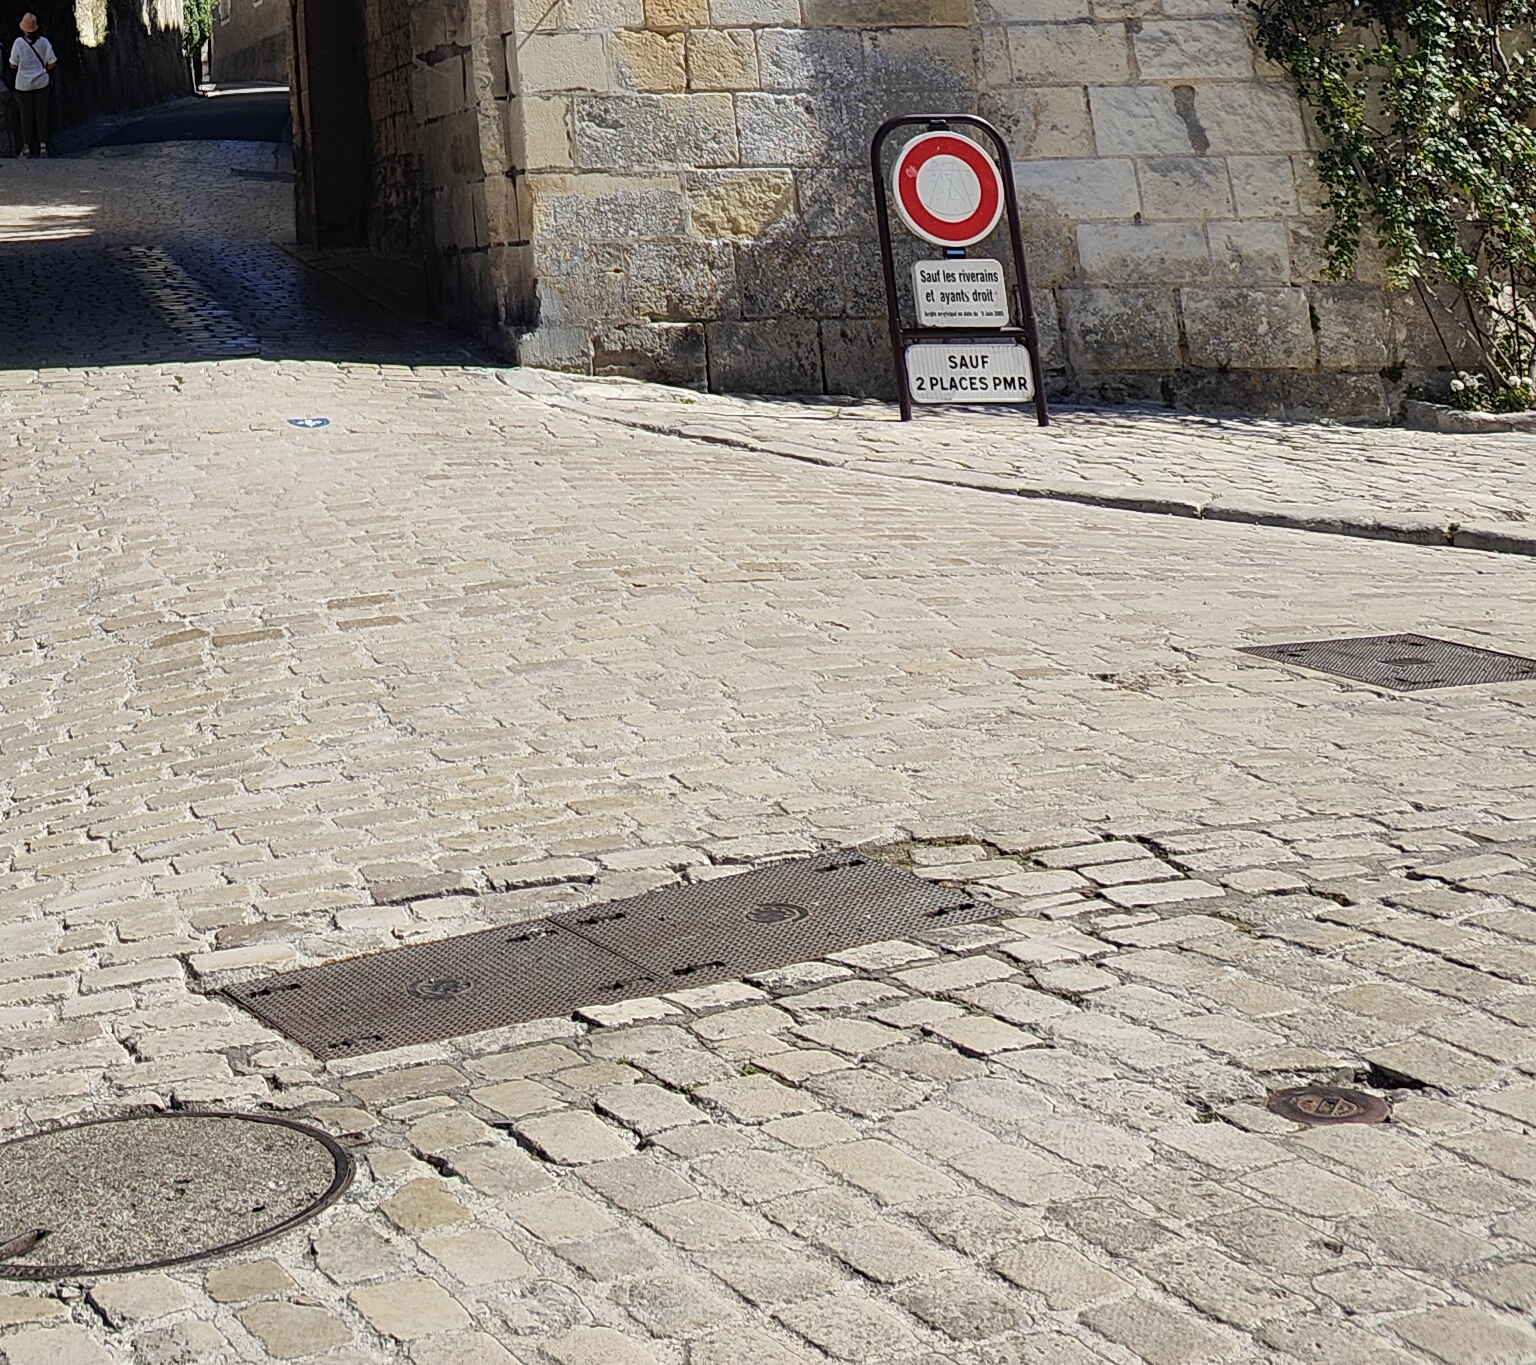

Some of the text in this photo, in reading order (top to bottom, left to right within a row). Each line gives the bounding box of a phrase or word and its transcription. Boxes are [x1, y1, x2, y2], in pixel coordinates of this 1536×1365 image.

[920, 268, 999, 283] Sauf les riverains
[925, 288, 995, 305] et ayants droit
[948, 355, 989, 369] SAUF
[915, 376, 1029, 391] 2 PLACES PMR
